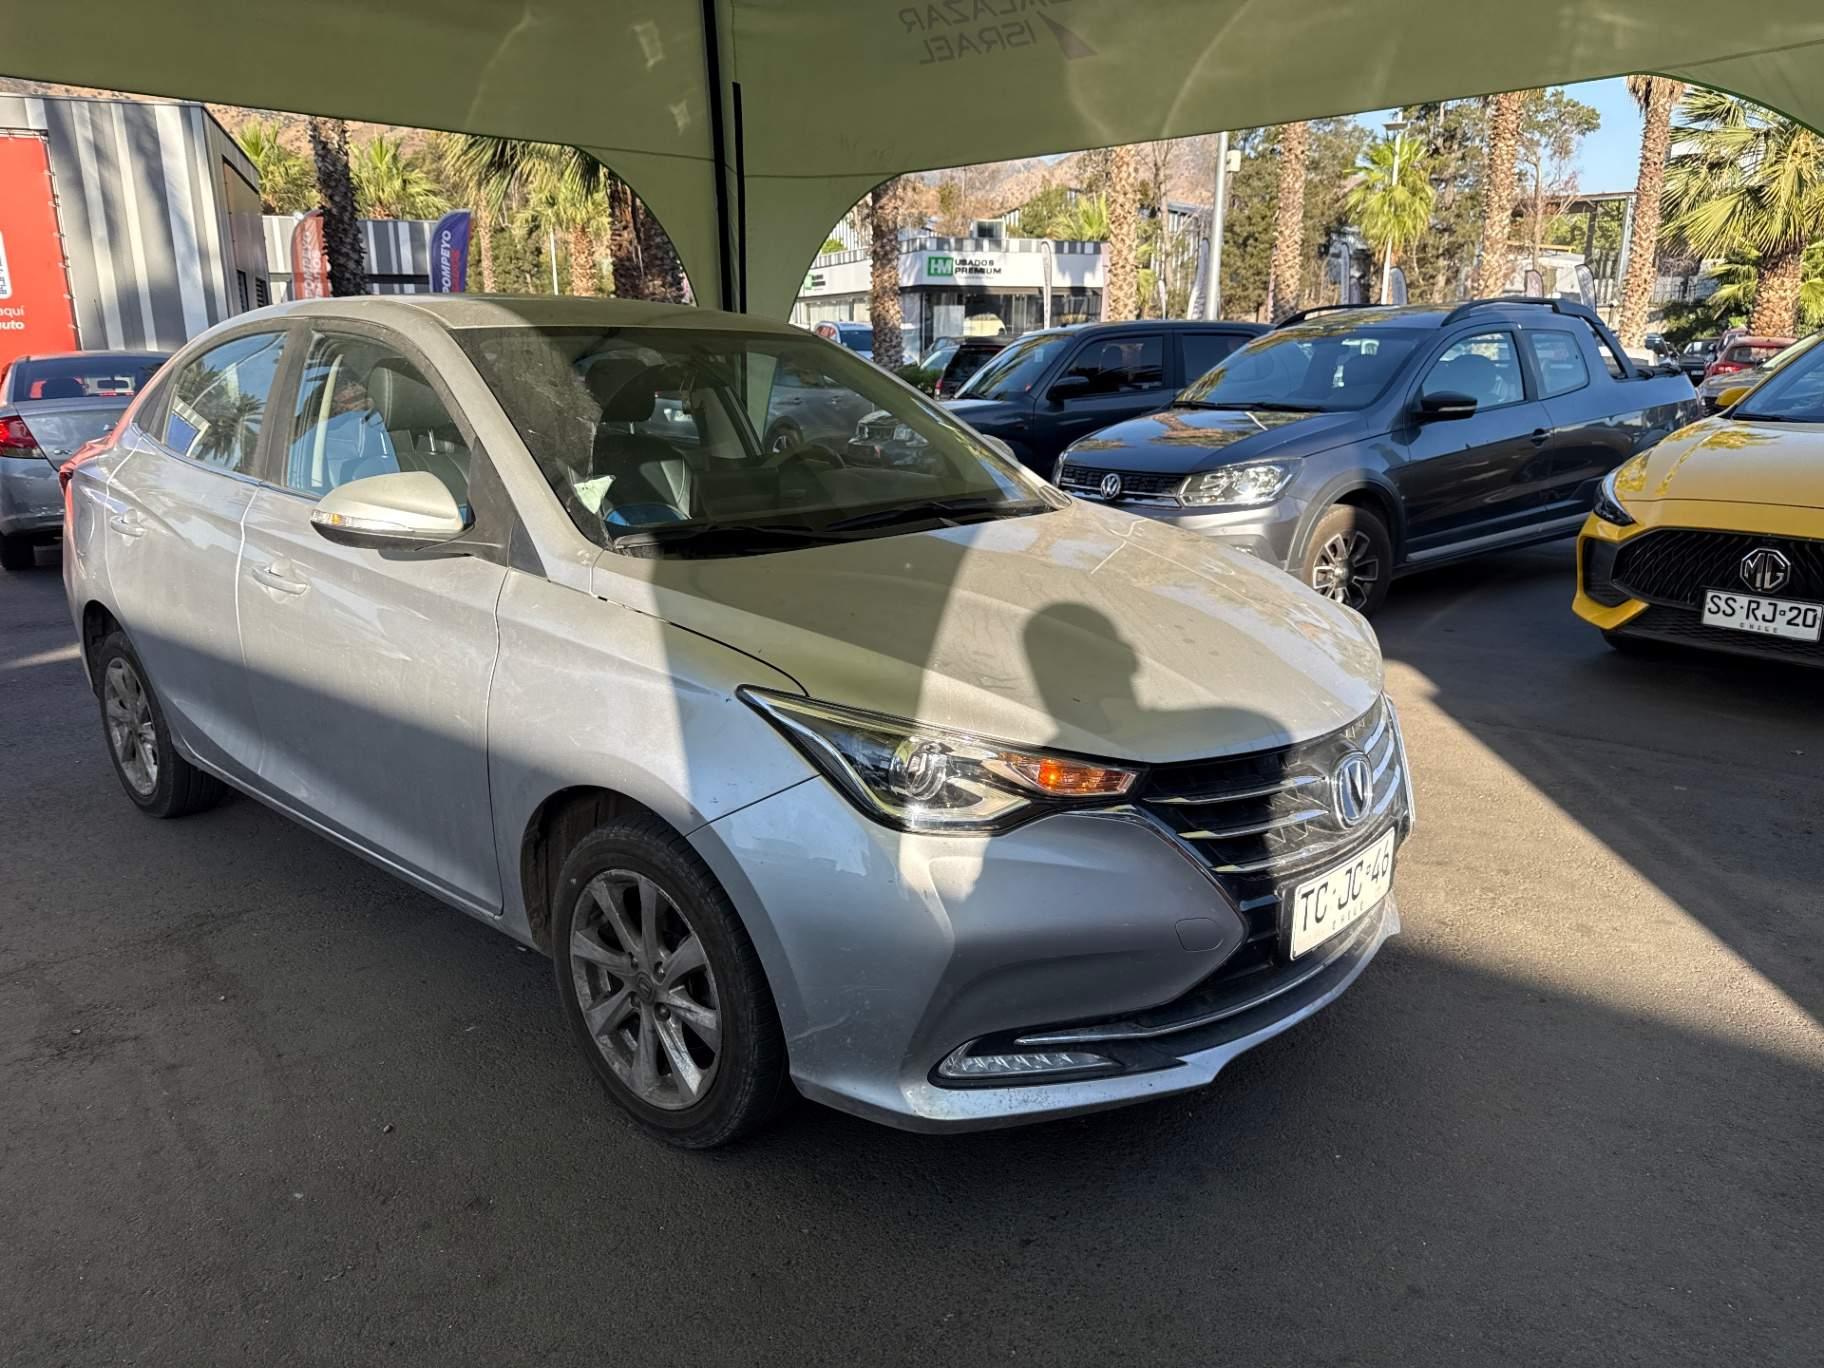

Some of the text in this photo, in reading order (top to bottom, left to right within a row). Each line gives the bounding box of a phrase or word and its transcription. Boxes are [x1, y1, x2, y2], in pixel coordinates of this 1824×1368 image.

[930, 258, 953, 274] HM
[955, 266, 1002, 274] PREMIUM
[1744, 553, 1786, 589] MG
